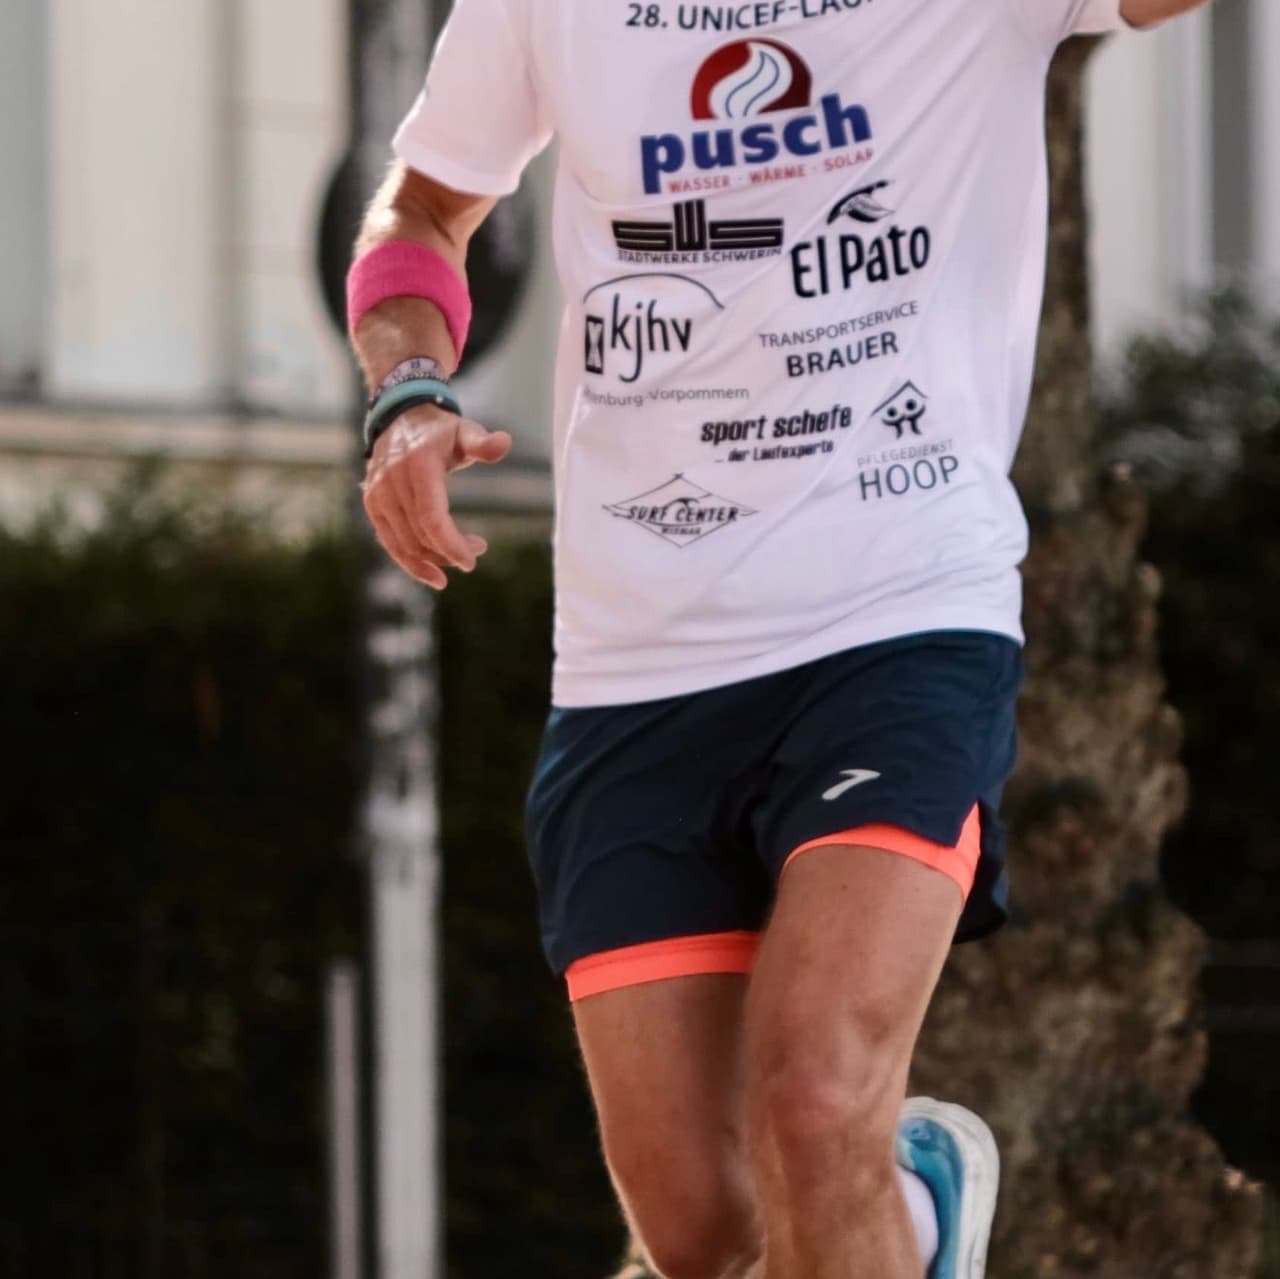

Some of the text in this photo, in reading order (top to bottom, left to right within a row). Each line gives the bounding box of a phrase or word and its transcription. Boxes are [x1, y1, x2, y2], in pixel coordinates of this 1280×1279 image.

[626, 2, 668, 28] 28.
[640, 93, 872, 195] pusch
[667, 175, 731, 193] WASSER
[749, 166, 806, 185] WÄRME
[617, 247, 782, 265] STADTWERKE SCHWERIN
[790, 224, 931, 299] El Pato
[610, 292, 692, 383] kjhv
[758, 299, 918, 350] TRANSPORTSERVICE
[785, 330, 899, 378] BRAUER
[700, 403, 852, 446] sport schefe
[859, 455, 959, 502] HOOP
[675, 506, 739, 523] CENTER
